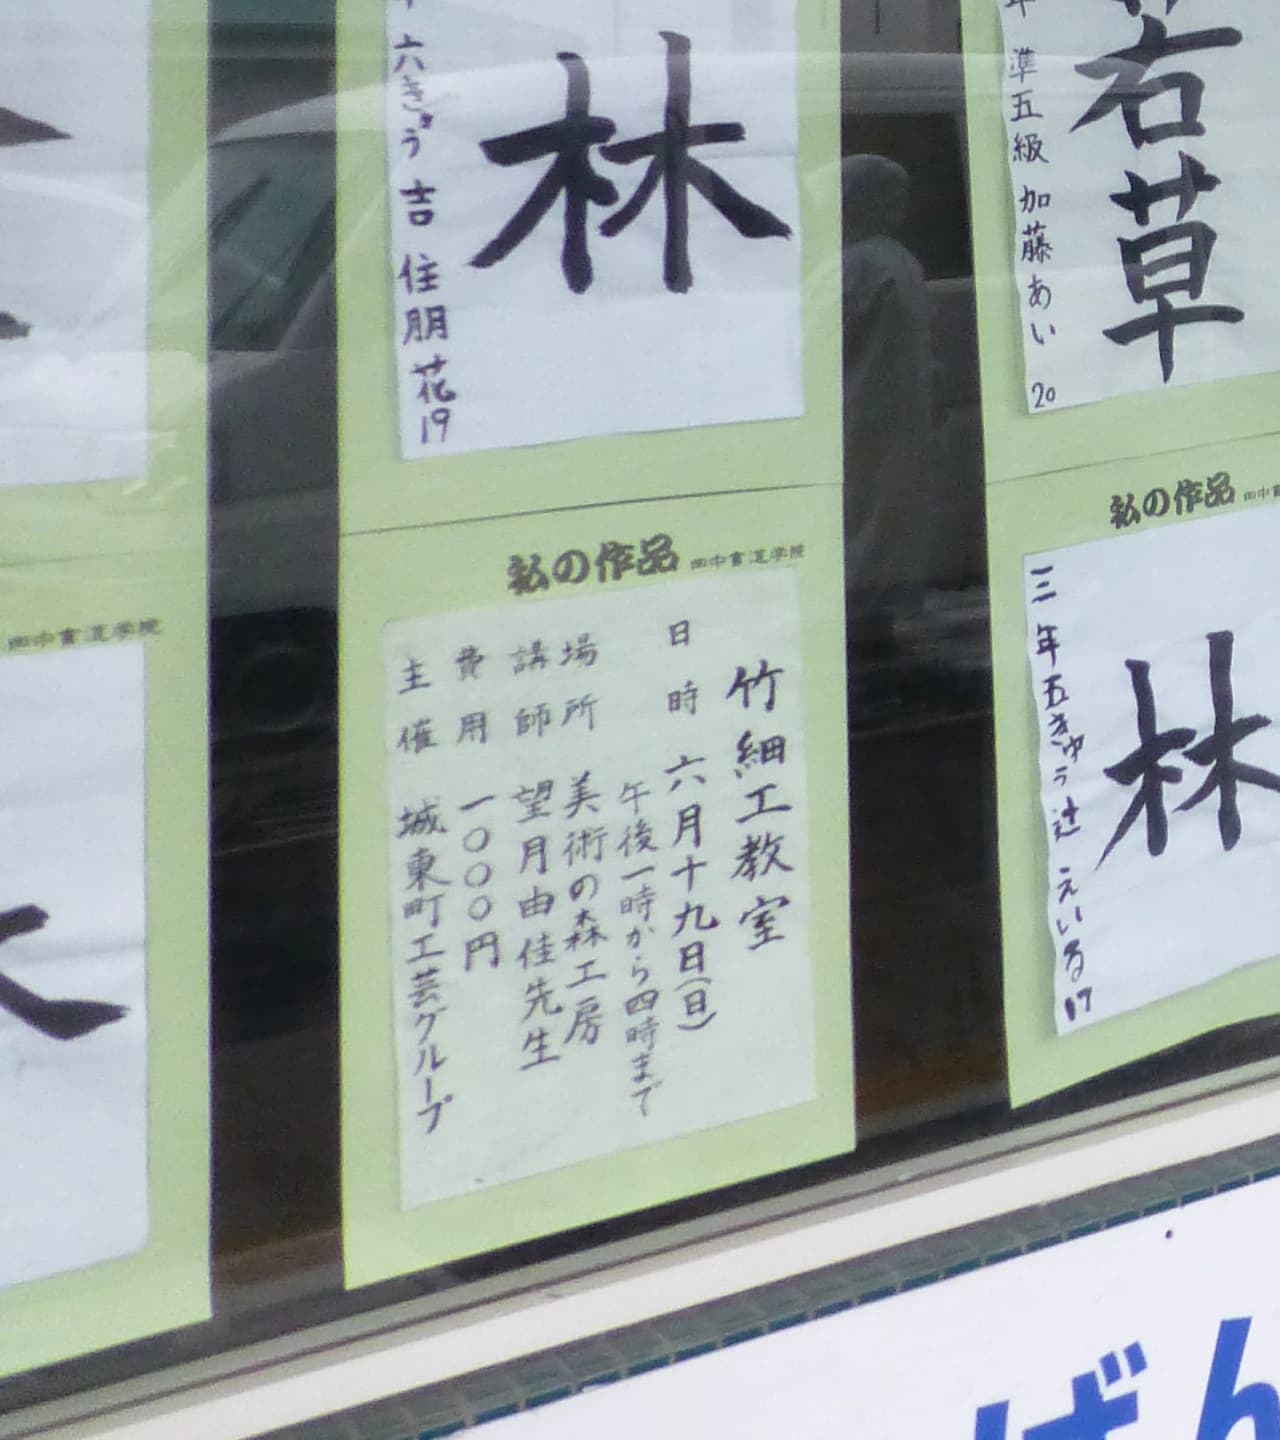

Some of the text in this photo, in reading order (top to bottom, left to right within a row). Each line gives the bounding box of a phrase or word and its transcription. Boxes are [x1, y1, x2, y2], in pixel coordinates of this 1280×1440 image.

[468, 29, 793, 295] 林
[1018, 184, 1056, 347] 加藤あい
[1031, 382, 1056, 410] 20
[1109, 472, 1235, 531] 私の作品
[506, 534, 679, 595] 私の作品
[397, 659, 438, 754] 主催
[453, 646, 489, 745] 費用
[511, 646, 553, 735] 講師
[560, 634, 600, 731] 場所
[666, 620, 700, 715] 日時
[726, 660, 795, 953] 竹細工教室
[617, 781, 665, 1119] 午後一時から四時まで
